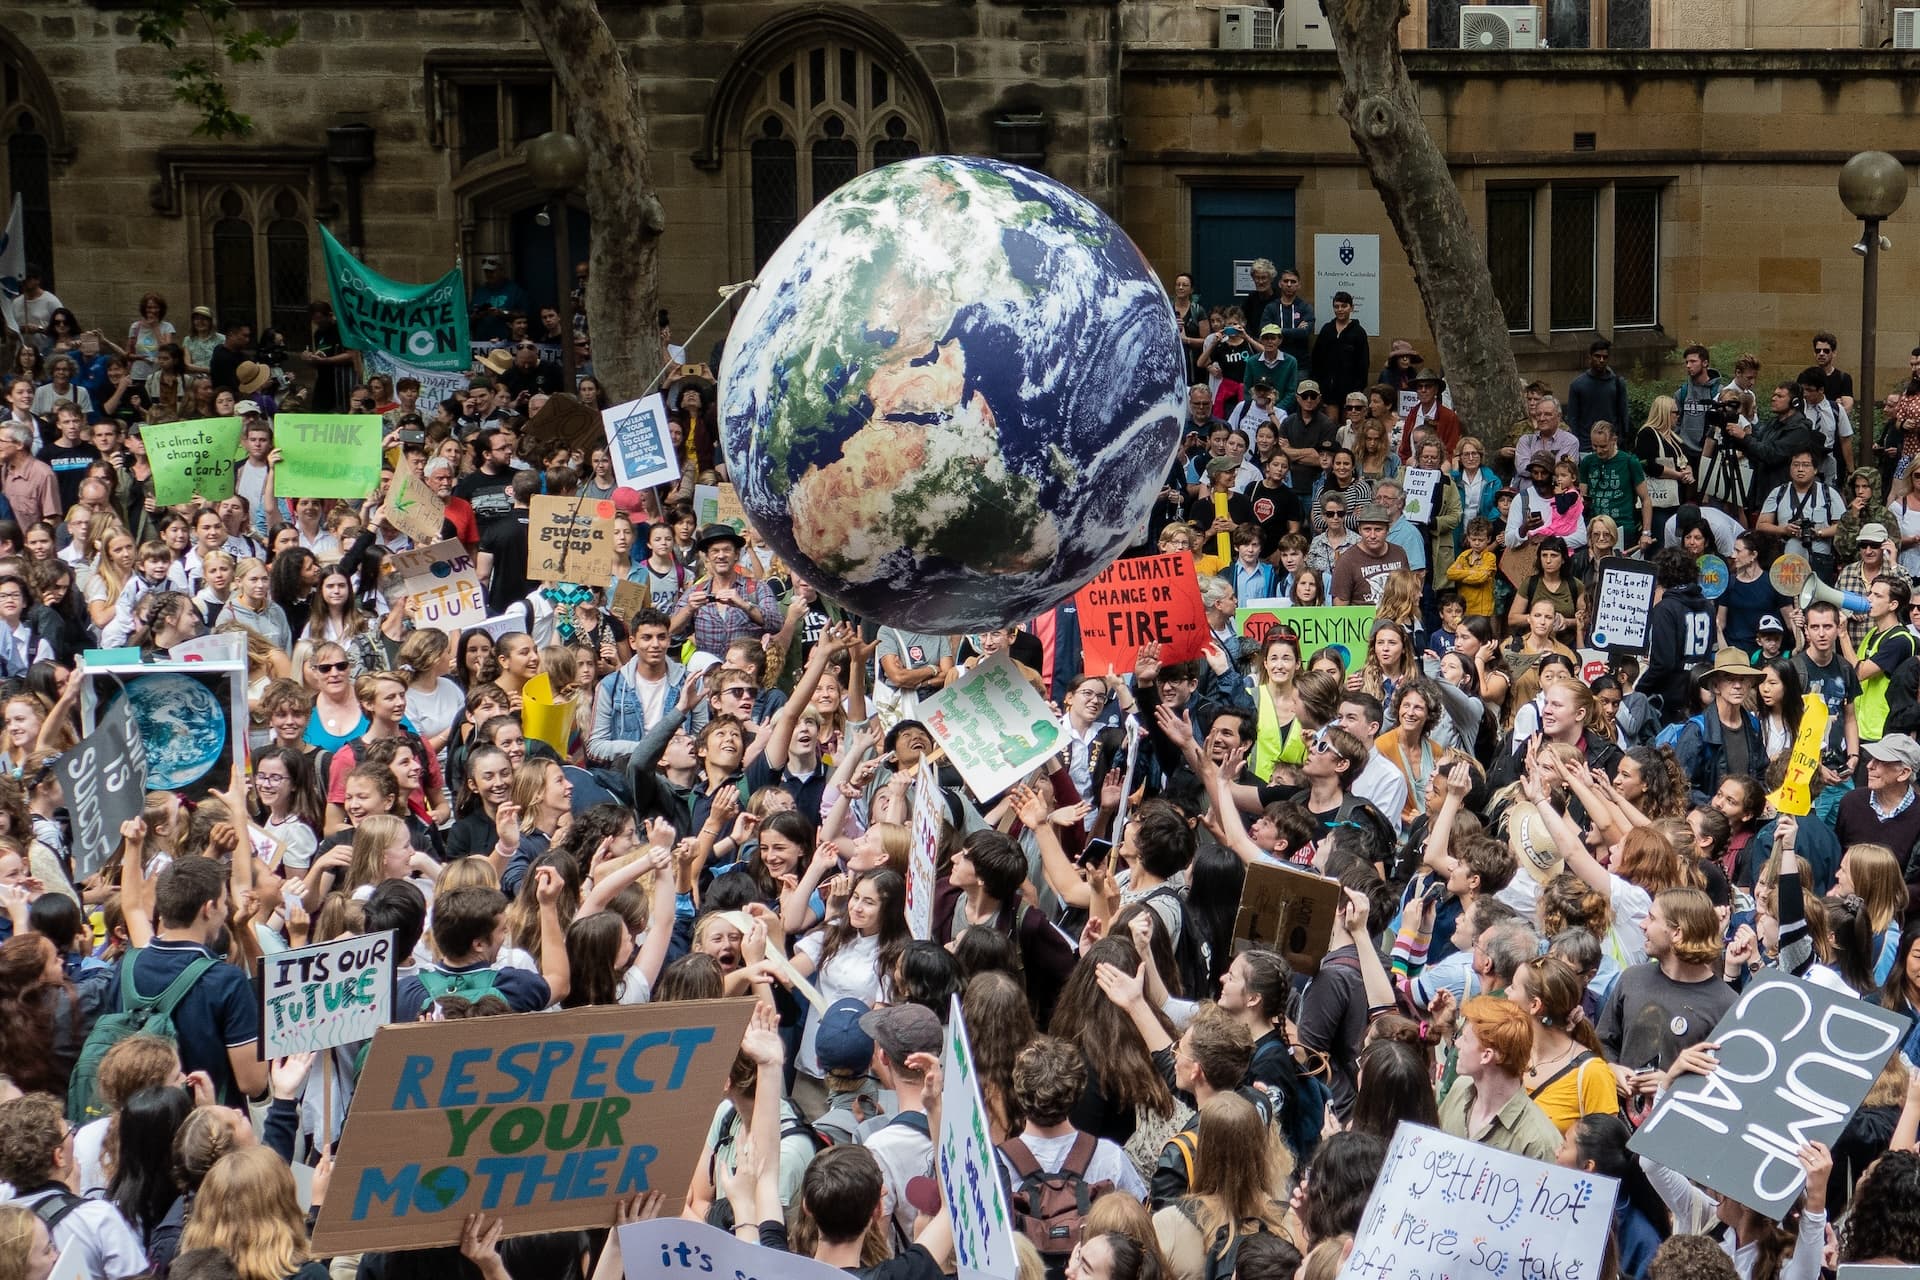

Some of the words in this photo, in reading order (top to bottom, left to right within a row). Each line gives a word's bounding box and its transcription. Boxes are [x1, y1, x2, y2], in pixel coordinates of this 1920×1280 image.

[342, 286, 455, 328] CLIMATE
[156, 438, 165, 449] is
[168, 430, 213, 448] climate
[293, 424, 364, 446] THINK
[167, 450, 210, 464] change
[184, 467, 193, 477] a
[1409, 470, 1432, 478] DON'T
[1406, 488, 1428, 496] TREES
[1119, 556, 1184, 581] CLIMATE
[1606, 572, 1622, 586] The
[1623, 575, 1649, 588] Earth
[1089, 587, 1147, 606] CHANGE
[1152, 586, 1172, 601] OR
[1601, 596, 1616, 609] hot
[1108, 610, 1173, 647] FIRE
[1176, 624, 1196, 632] YOU
[1684, 611, 1711, 656] 19
[928, 709, 952, 741] Time
[67, 746, 111, 874] SUICIDE
[337, 939, 390, 973] OUR
[391, 1026, 717, 1111] RESPECT
[1643, 980, 1812, 1135] COAL
[1741, 1004, 1900, 1202] DUMP
[446, 1096, 632, 1157] YOUR
[351, 1145, 659, 1222] MOTHER
[1411, 1151, 1522, 1227] getting
[1529, 1175, 1587, 1225] hot
[661, 1241, 713, 1272] it's
[1350, 1246, 1396, 1279] off
[1469, 1241, 1503, 1272] so
[1519, 1240, 1583, 1280] take
